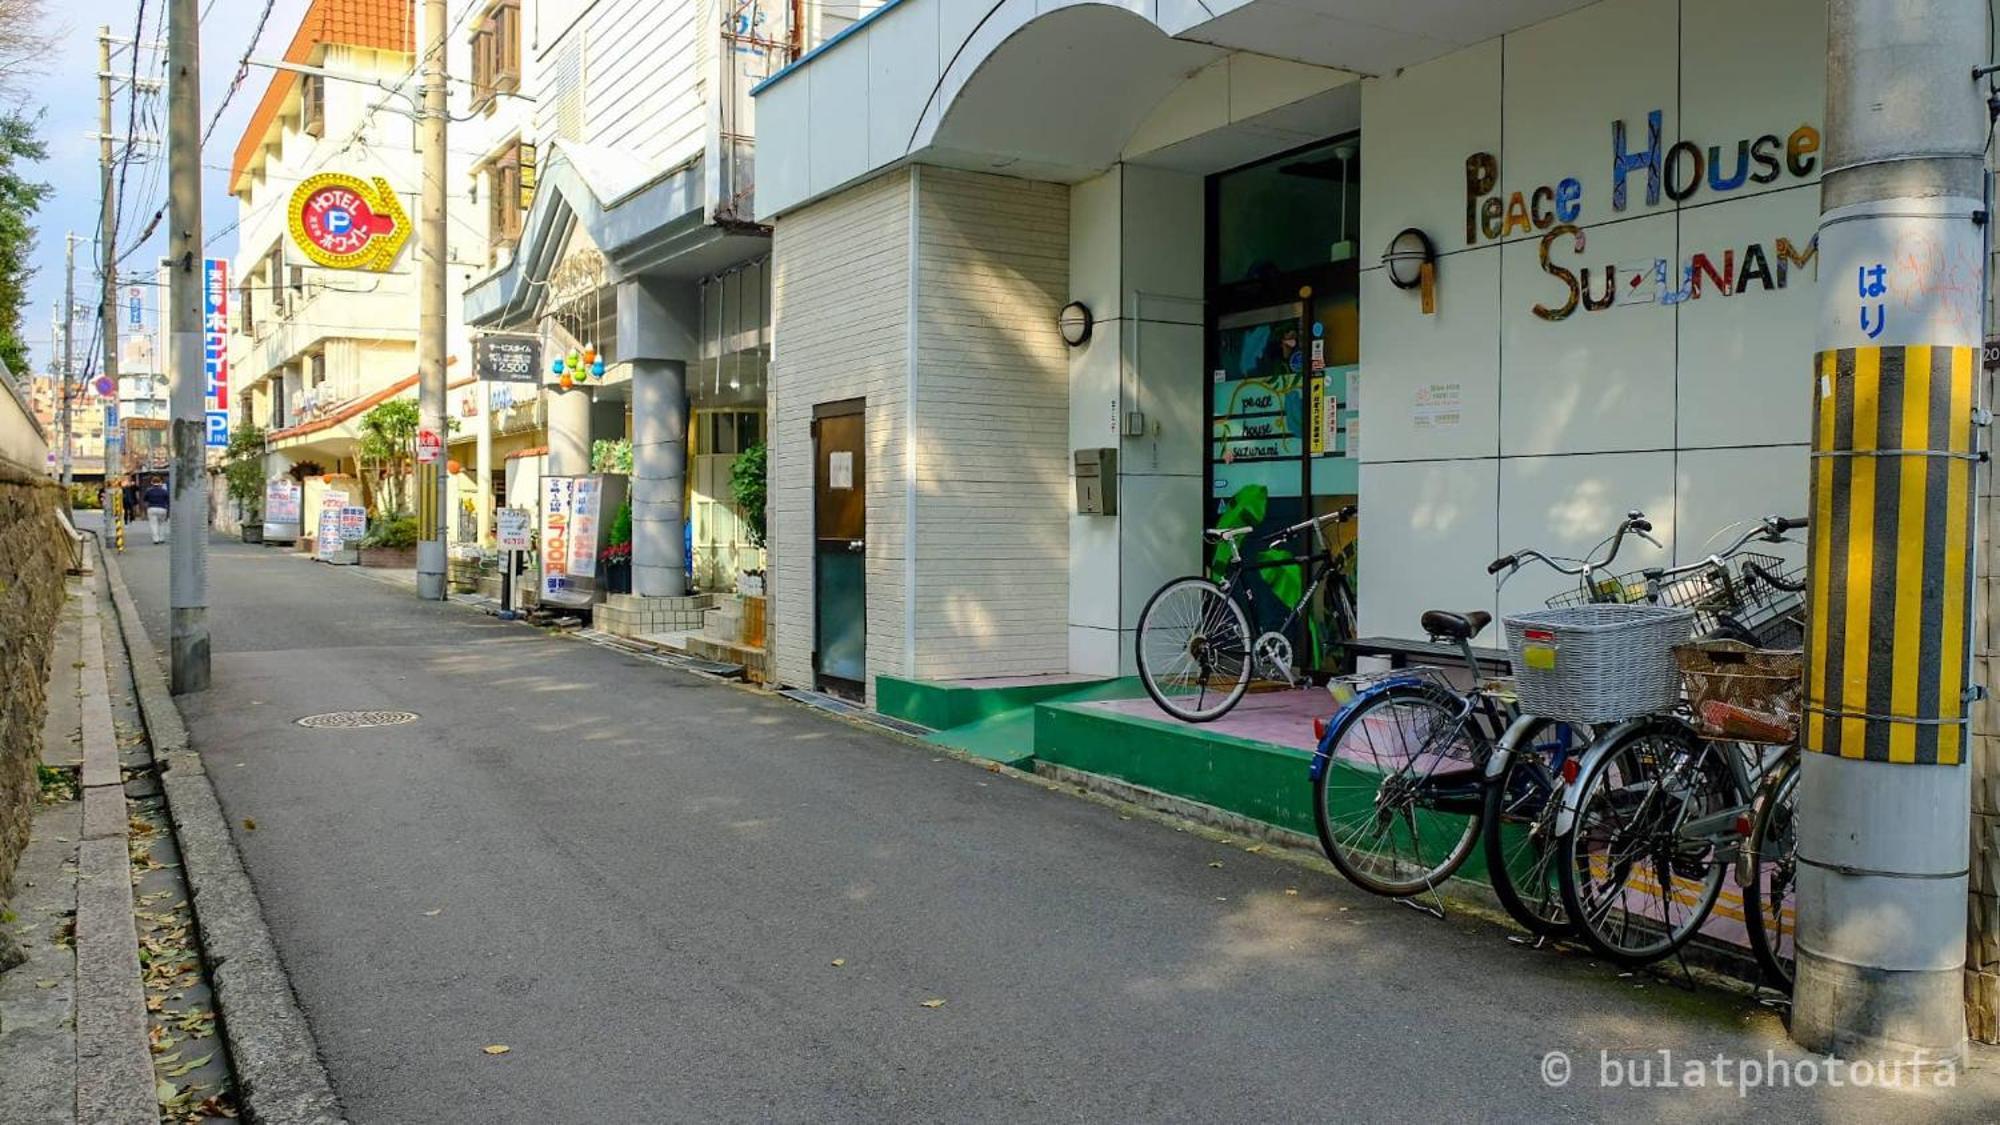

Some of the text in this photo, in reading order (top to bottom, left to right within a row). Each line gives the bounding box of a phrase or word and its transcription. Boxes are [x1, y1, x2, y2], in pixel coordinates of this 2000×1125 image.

[309, 190, 361, 216] HOTEL
[328, 210, 351, 232] P
[319, 224, 369, 252] ホワイト
[1858, 263, 1888, 339] はり
[1241, 394, 1273, 415] peace
[206, 415, 227, 442] P
